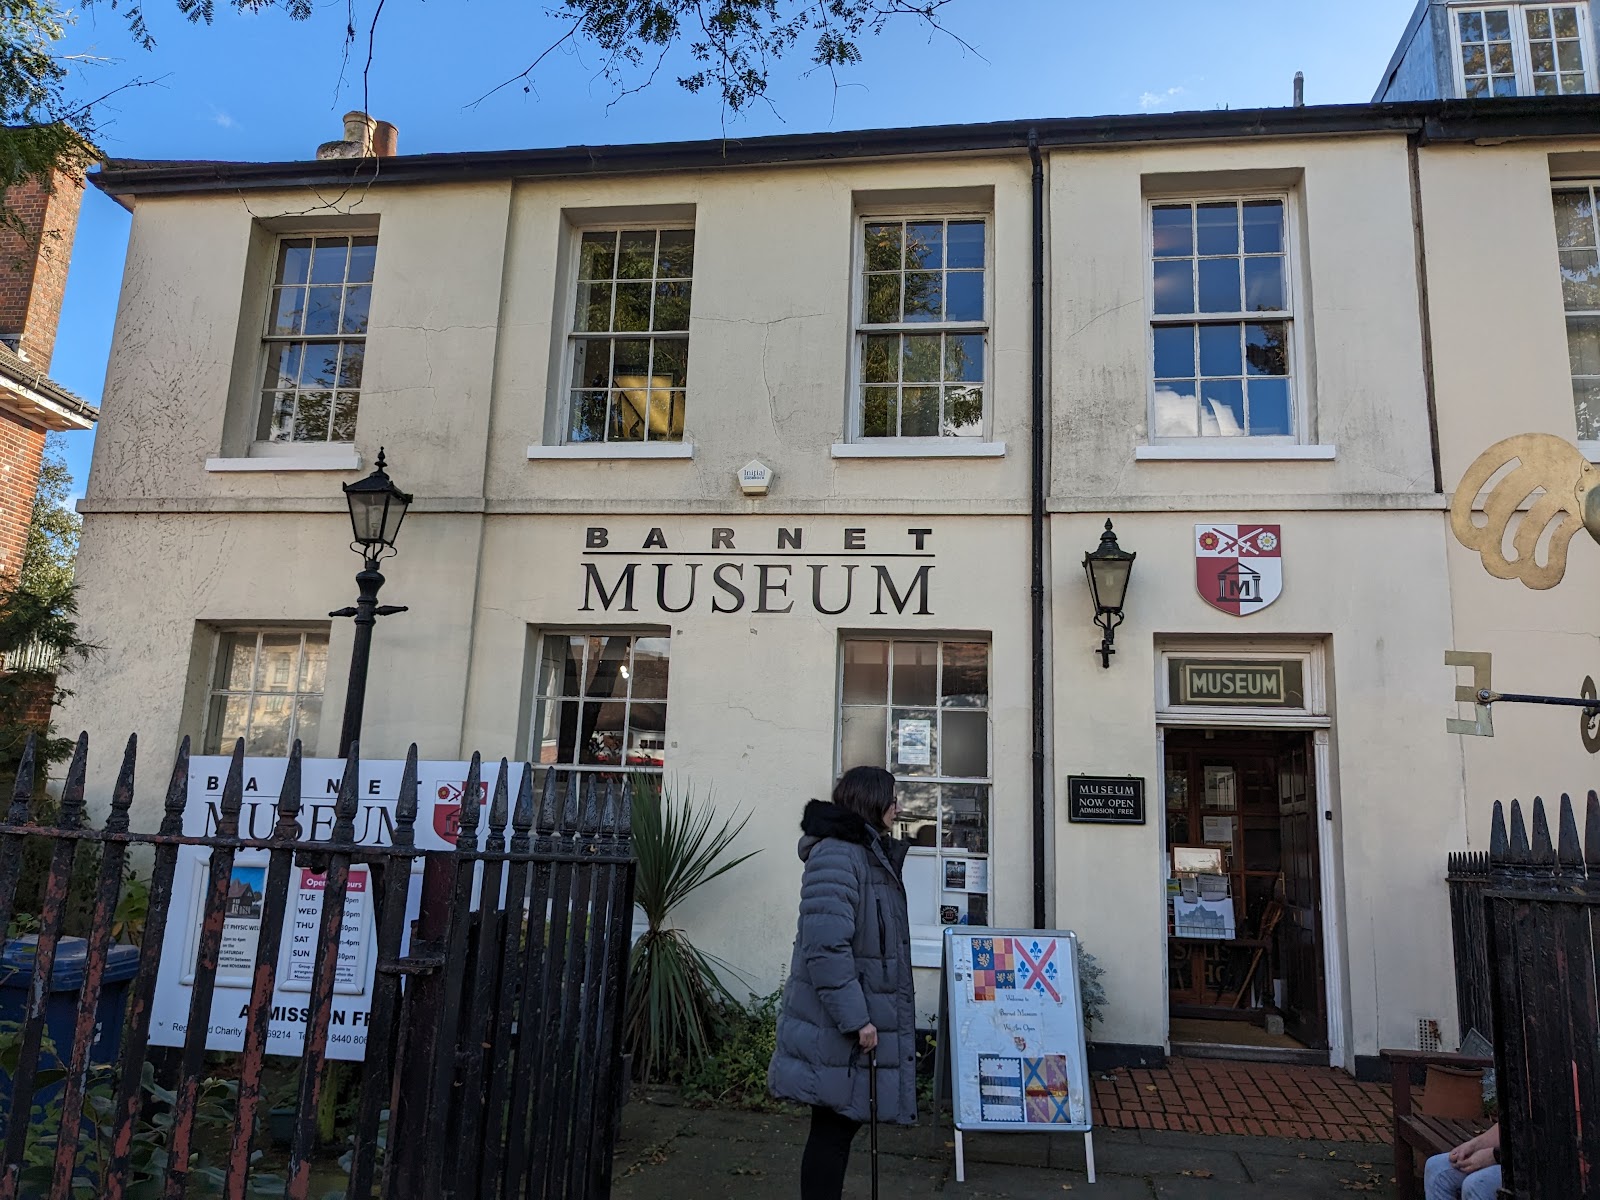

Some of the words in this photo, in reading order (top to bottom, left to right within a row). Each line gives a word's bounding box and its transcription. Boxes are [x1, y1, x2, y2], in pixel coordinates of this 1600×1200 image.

[585, 527, 933, 551] BARNET
[577, 562, 936, 616] MUSEUM
[1229, 579, 1251, 597] M
[1192, 671, 1278, 696] MUSEUM
[206, 775, 423, 796] BANE
[1079, 784, 1135, 795] MUSEUM
[1079, 798, 1105, 807] NOW
[1108, 798, 1134, 808] OPEN
[1079, 807, 1115, 815] ADMISSION
[300, 894, 316, 902] TUE
[298, 908, 318, 916] WED
[296, 921, 314, 929] THU
[294, 935, 309, 943] SAT
[292, 949, 310, 957] SUN
[214, 1025, 243, 1038] Charity
[331, 1033, 352, 1044] 8440
